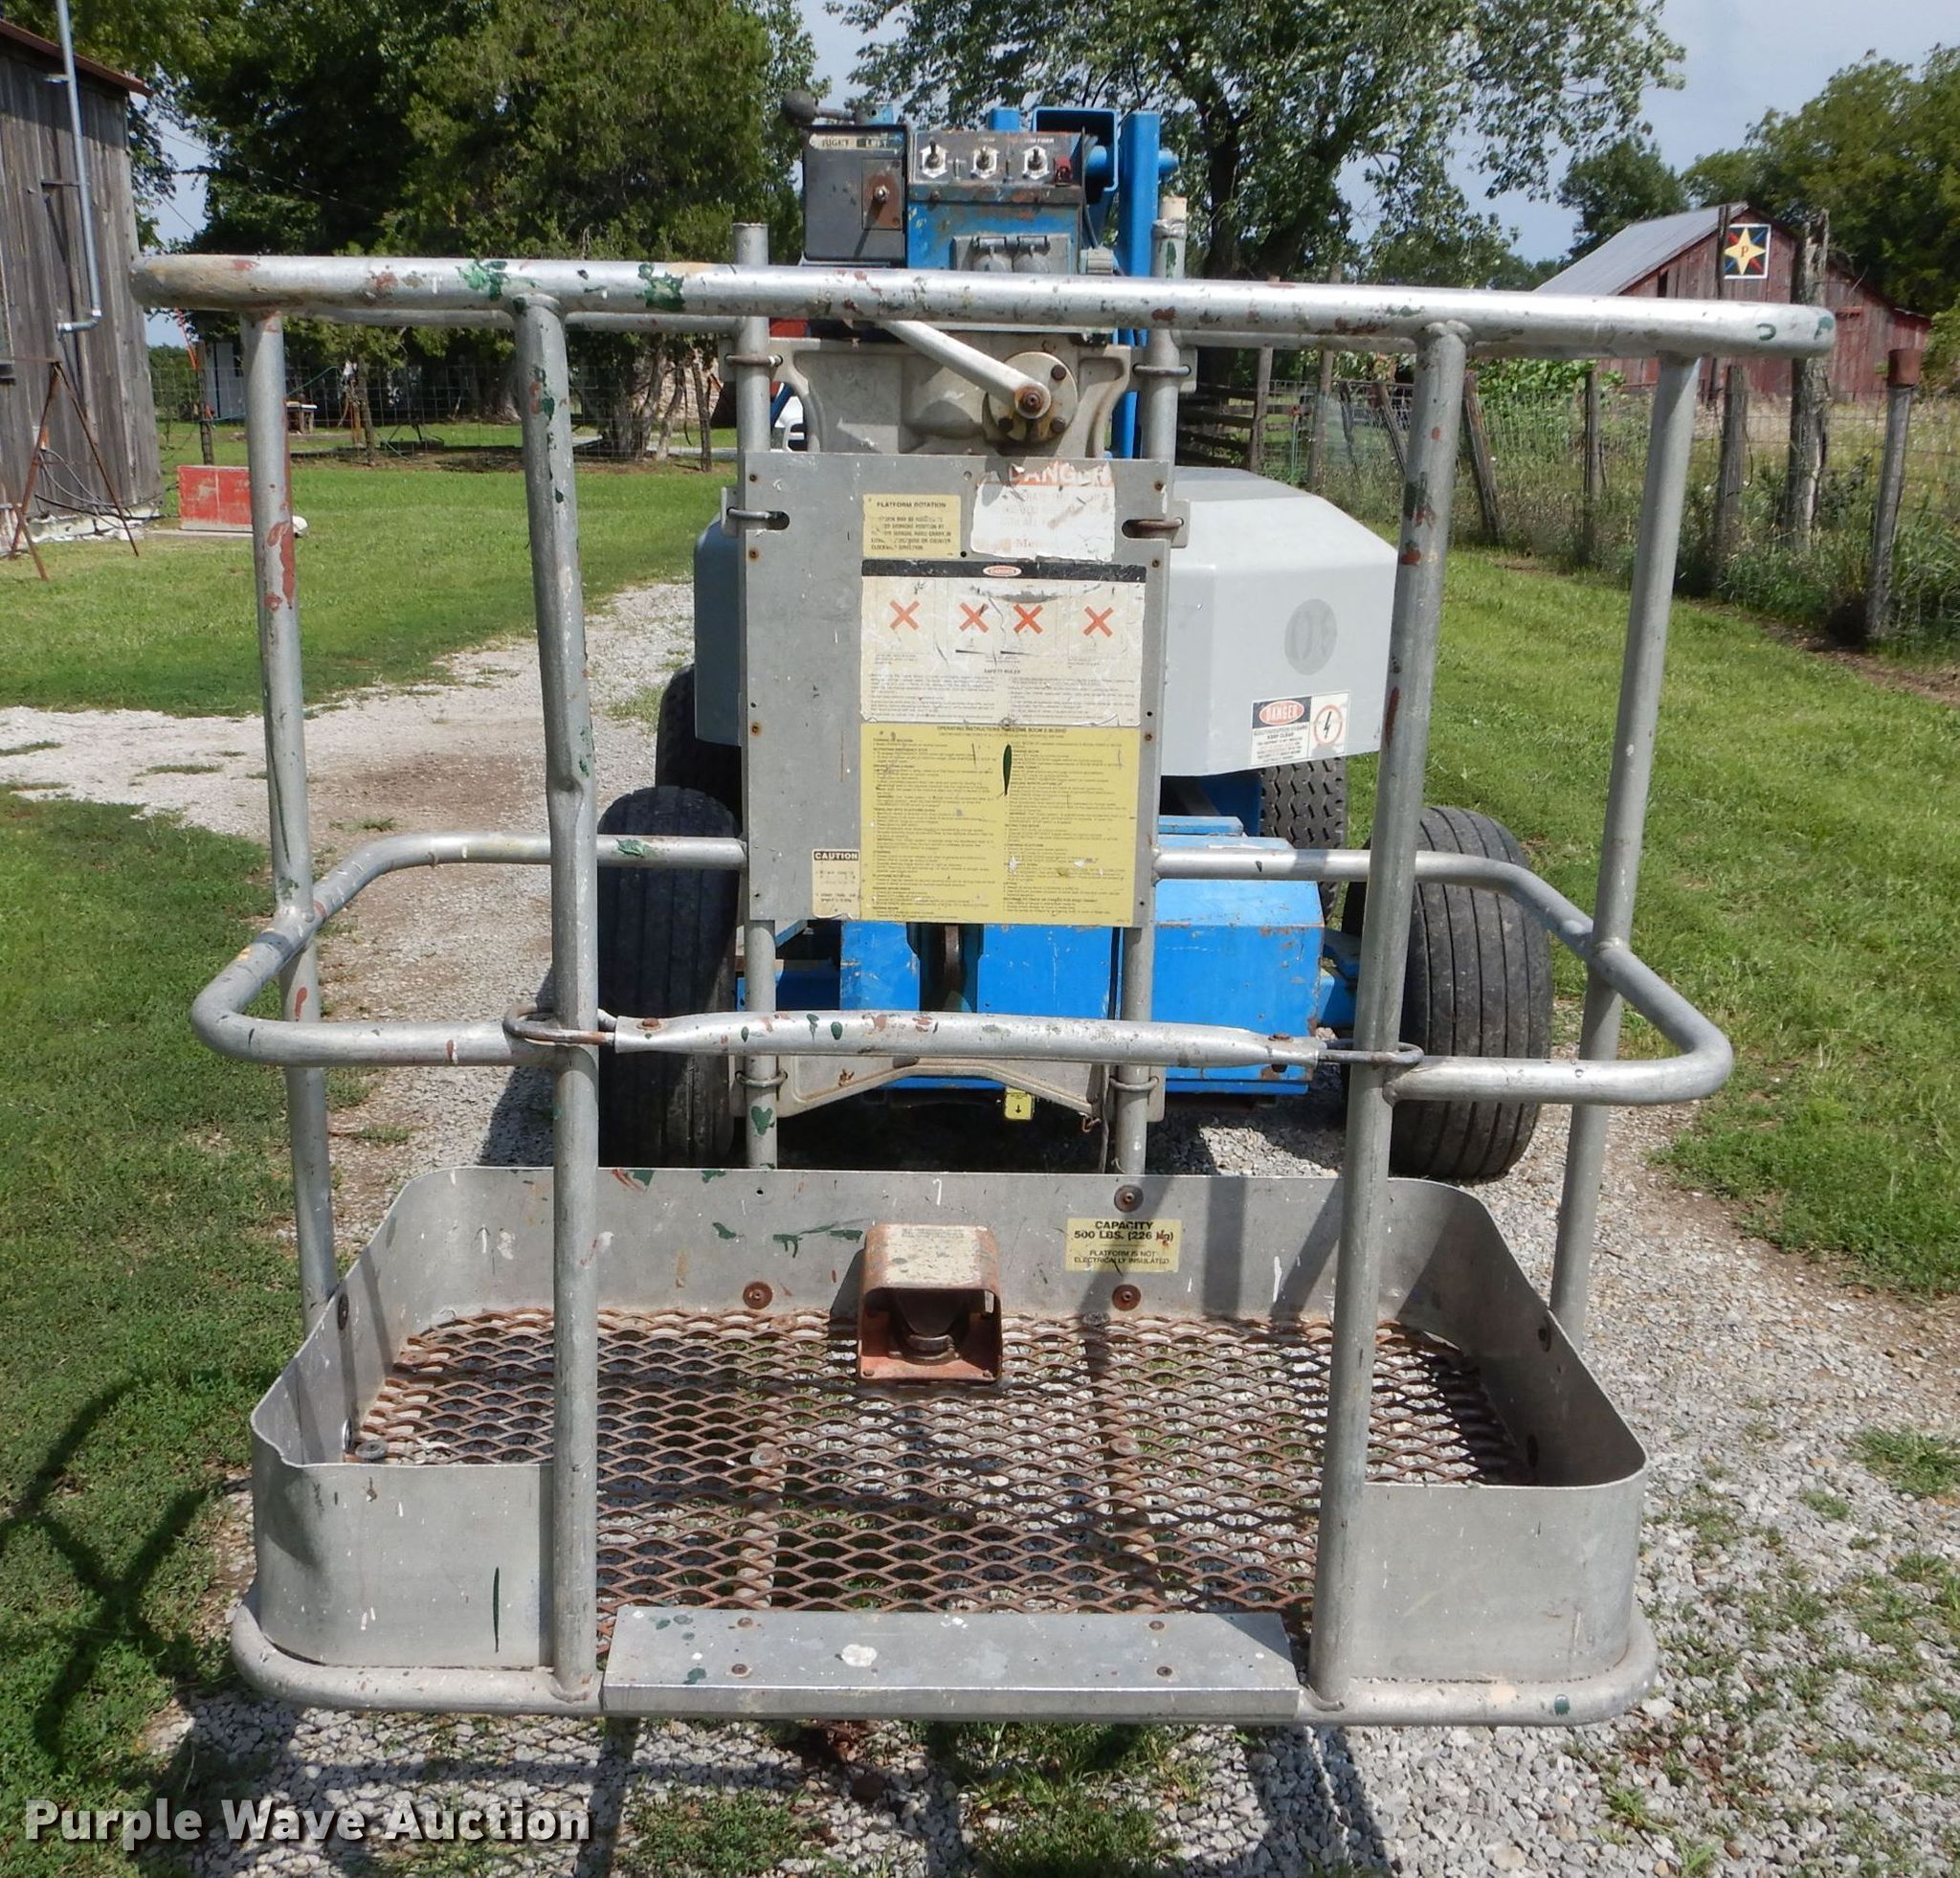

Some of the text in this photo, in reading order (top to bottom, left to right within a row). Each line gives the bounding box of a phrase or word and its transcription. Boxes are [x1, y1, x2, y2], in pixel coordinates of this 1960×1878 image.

[1095, 1220, 1154, 1230] CAPACITY
[1074, 1230, 1096, 1240] 500
[1127, 1231, 1152, 1241] (226
